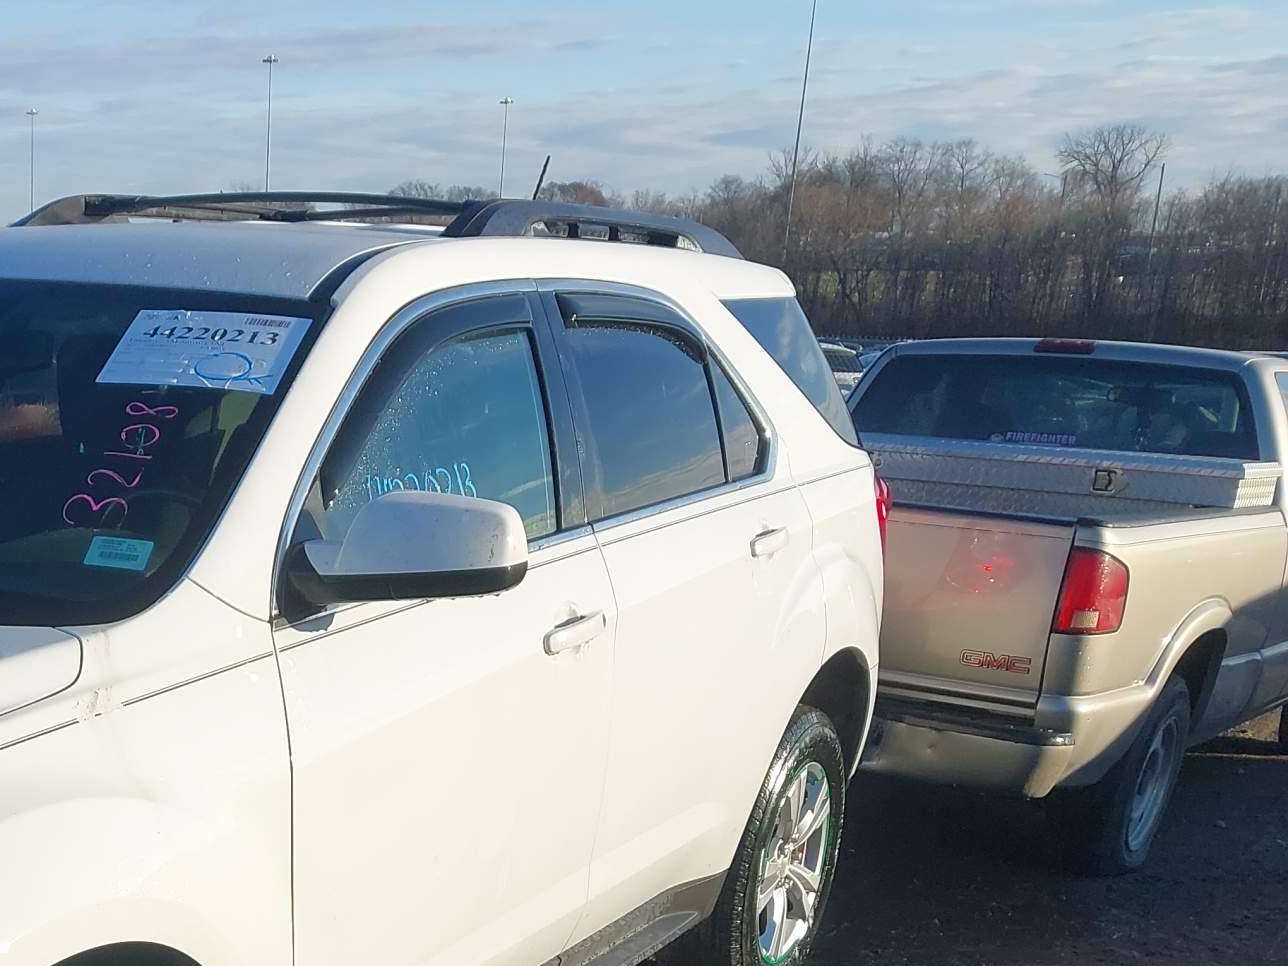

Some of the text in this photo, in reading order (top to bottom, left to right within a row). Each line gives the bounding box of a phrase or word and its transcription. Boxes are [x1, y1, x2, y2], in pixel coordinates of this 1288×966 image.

[143, 325, 280, 346] 44220213
[1005, 431, 1077, 445] FIREFIGHTER
[960, 649, 1032, 675] GMC
